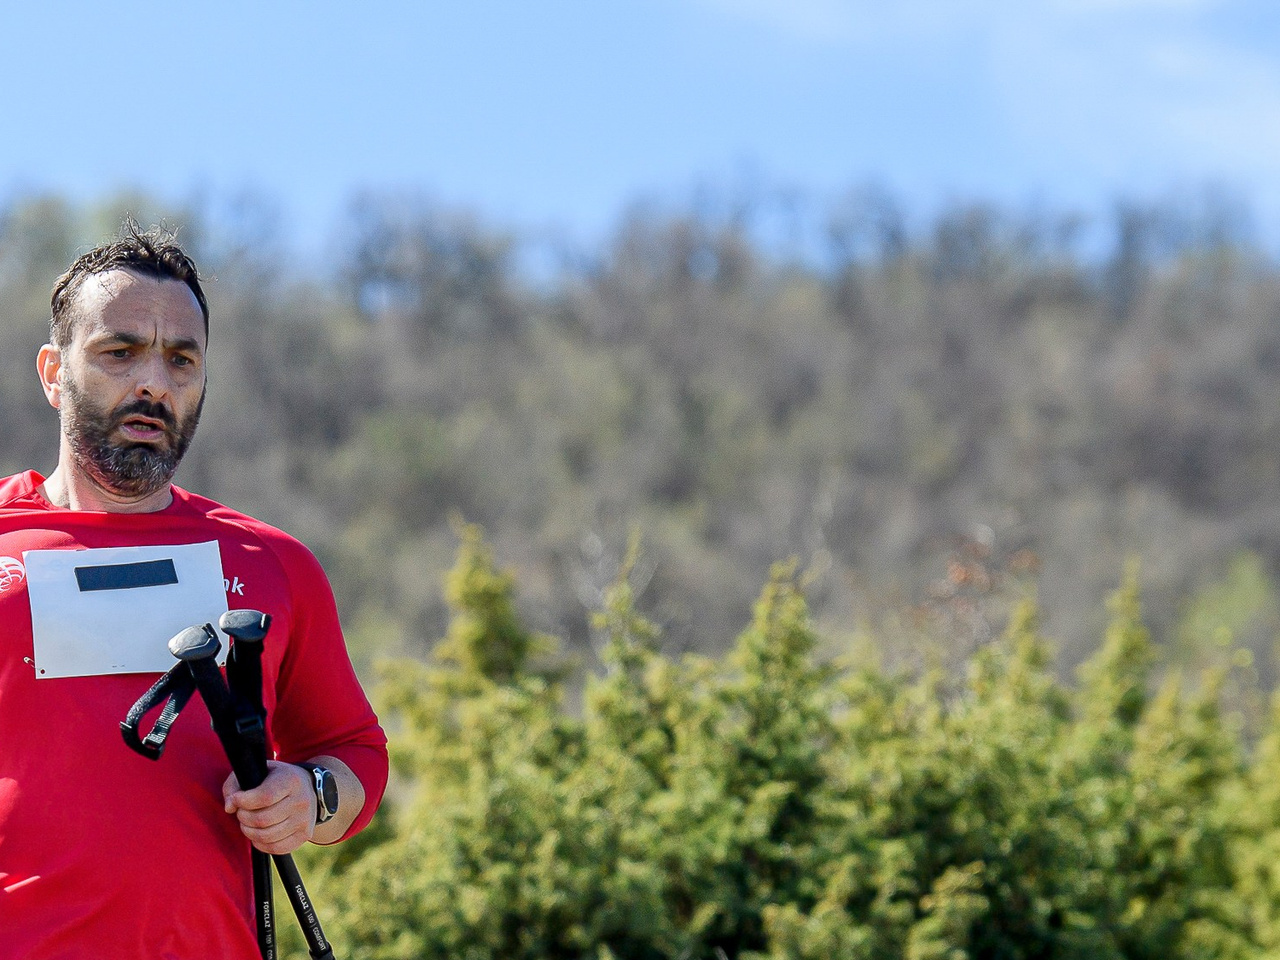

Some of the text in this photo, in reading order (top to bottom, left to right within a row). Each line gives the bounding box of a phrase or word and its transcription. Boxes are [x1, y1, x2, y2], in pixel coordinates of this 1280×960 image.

[263, 901, 271, 928] FORCLAZ
[295, 884, 326, 951] FORCLAZ 100 COMFORT
